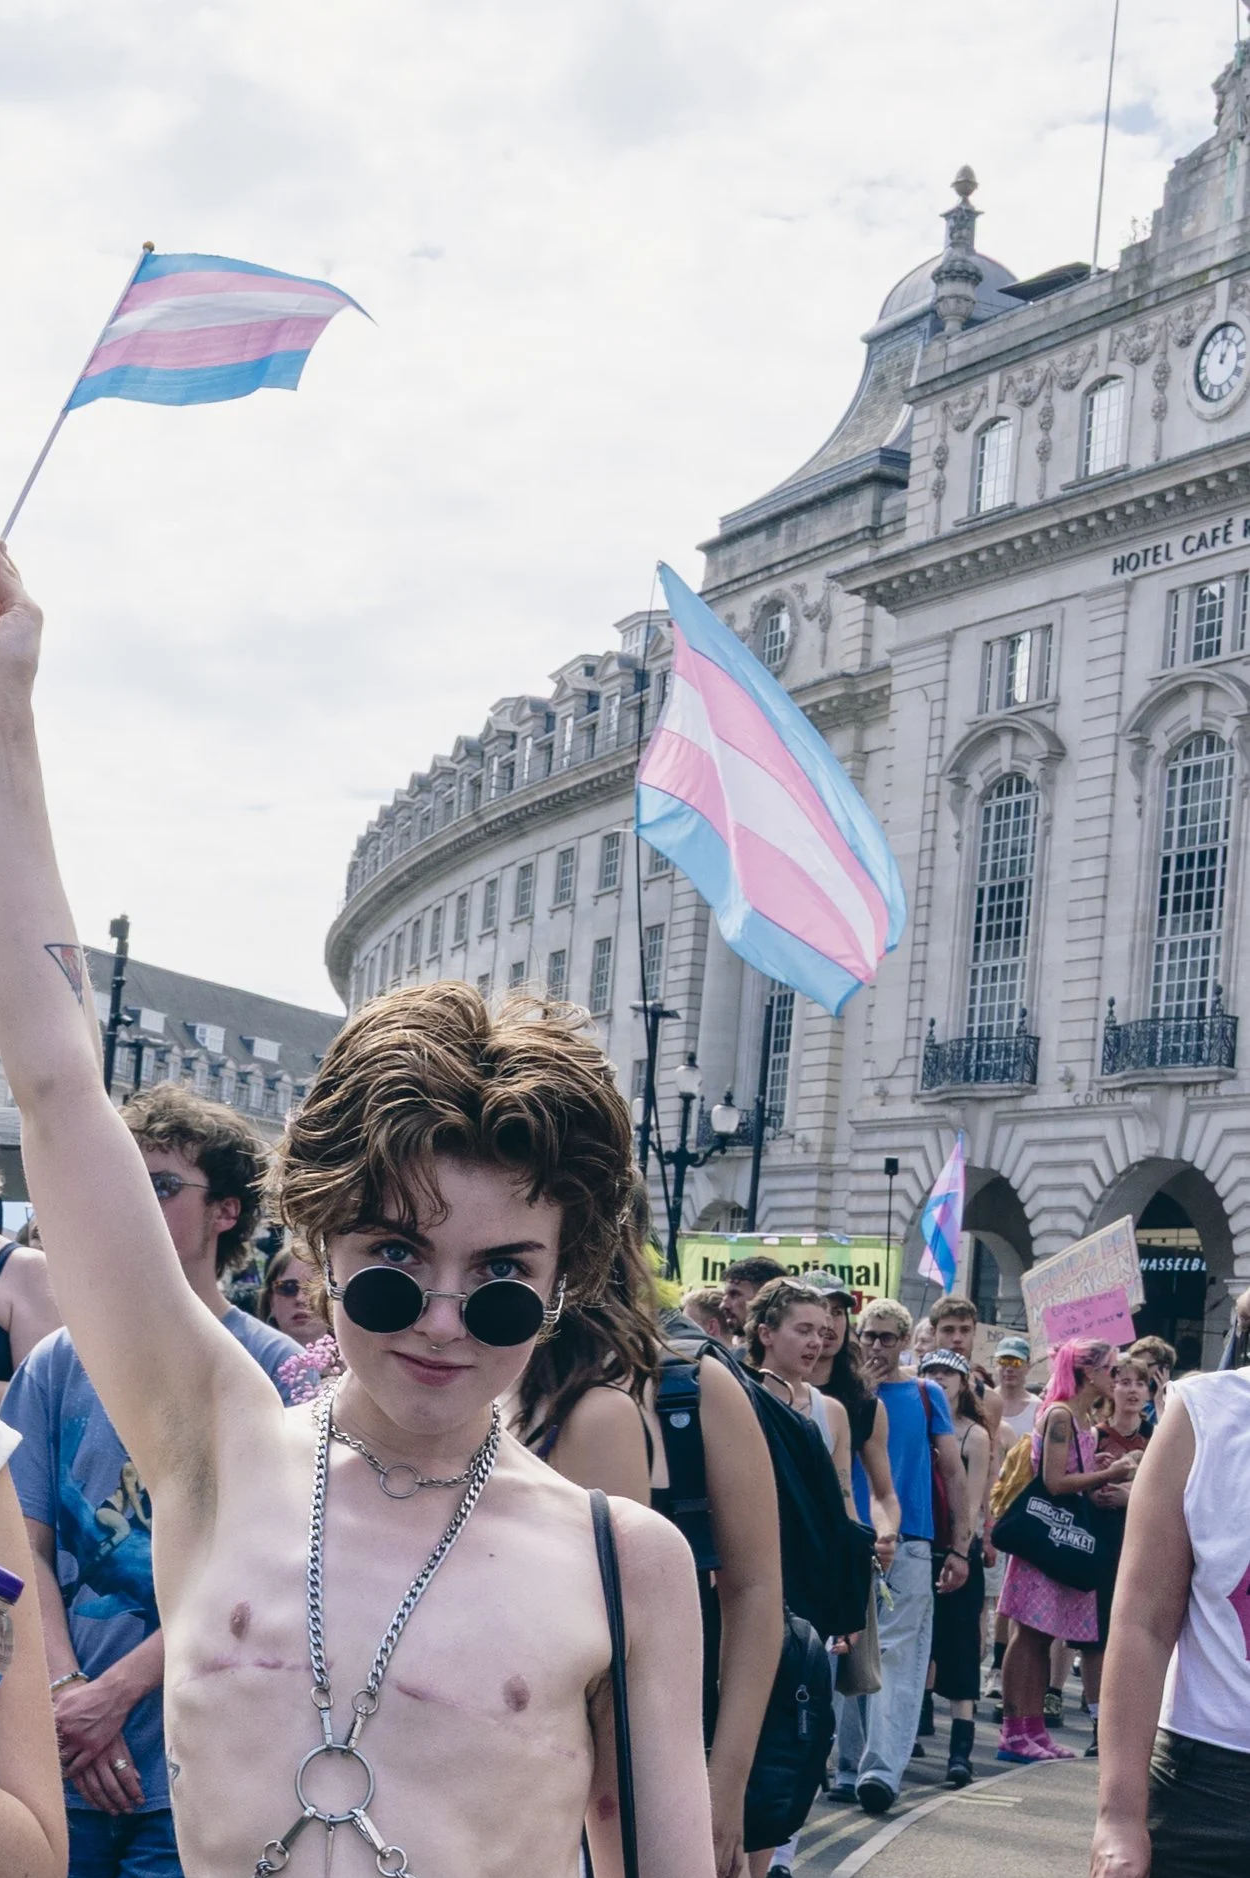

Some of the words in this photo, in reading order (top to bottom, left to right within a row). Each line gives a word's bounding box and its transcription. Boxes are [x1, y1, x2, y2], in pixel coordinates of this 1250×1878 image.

[1112, 542, 1173, 576] HOTEL
[1182, 518, 1233, 555] CAFÉ
[703, 1257, 880, 1286] Inatonal
[1030, 1500, 1070, 1523] BROCKLEY
[1051, 1526, 1093, 1550] MARKET
